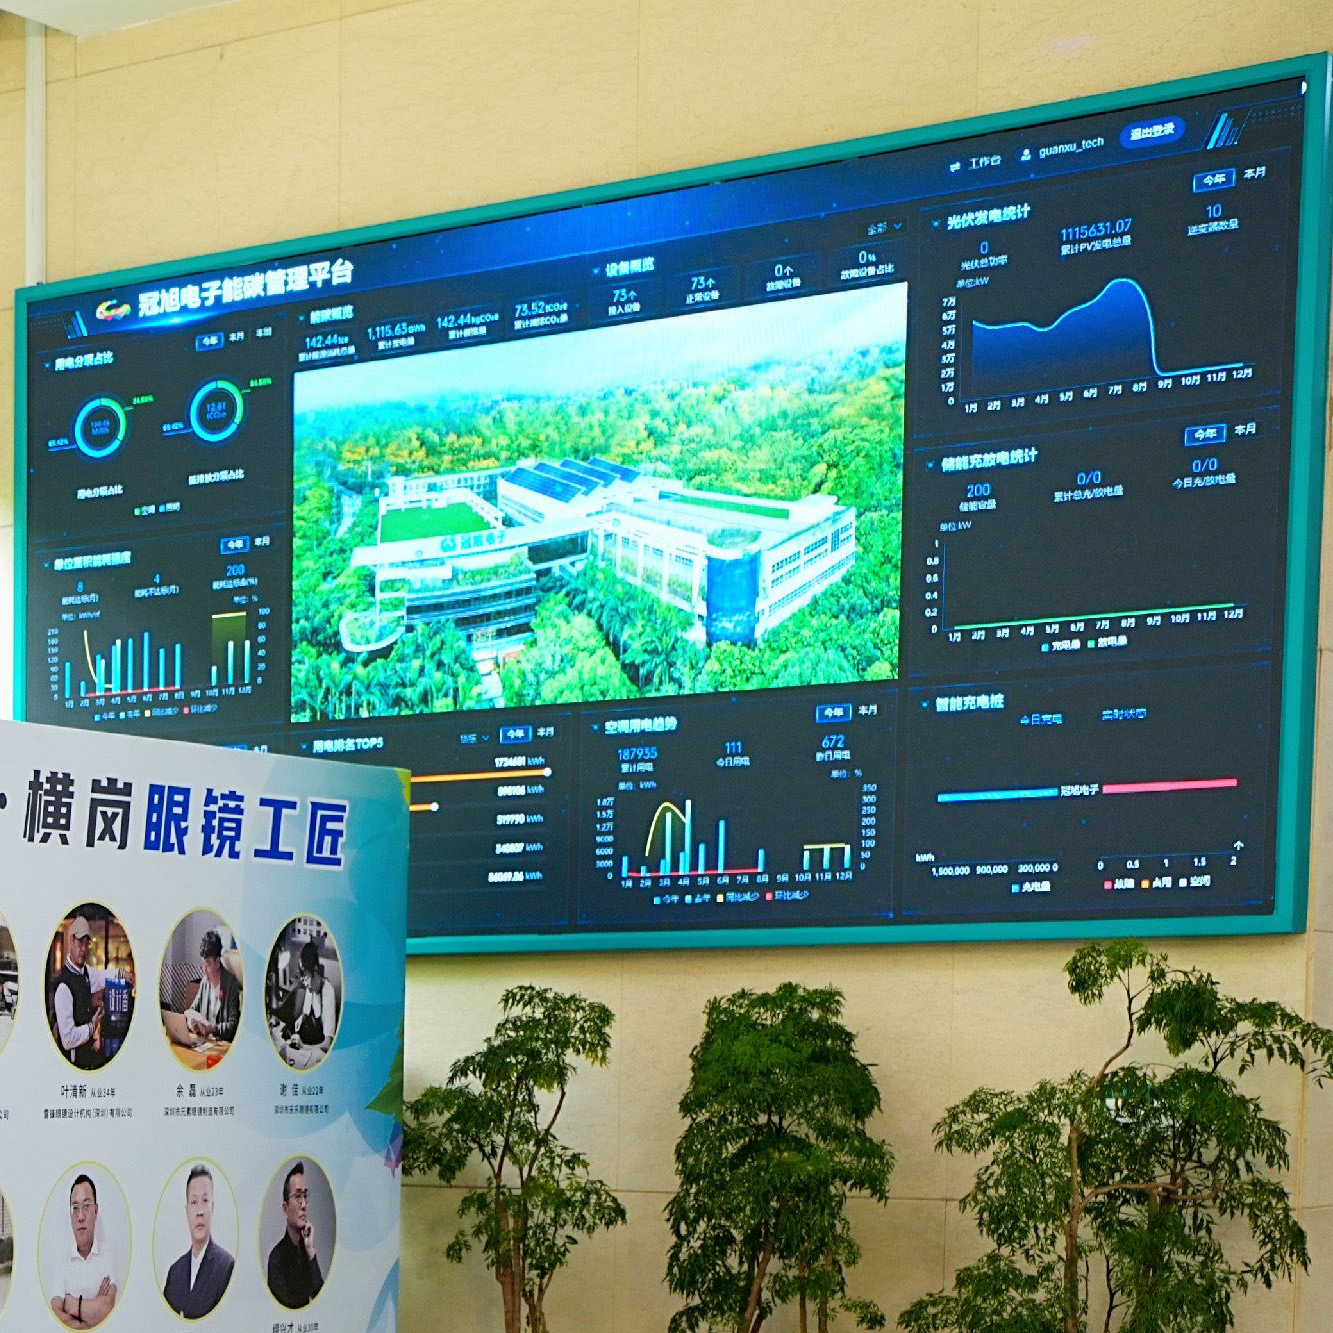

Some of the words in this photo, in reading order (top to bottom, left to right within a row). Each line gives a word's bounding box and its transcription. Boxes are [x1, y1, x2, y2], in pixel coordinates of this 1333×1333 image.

[968, 155, 1002, 170] 工作台
[1203, 173, 1226, 187] 今年
[1243, 166, 1266, 181] 本月
[947, 203, 1030, 230] 光伏发电统计
[1206, 204, 1222, 218] 10
[1060, 218, 1132, 241] 1115631.07
[139, 258, 354, 317] 冠旭电子能碳管理平台
[1195, 427, 1217, 441] 今年
[1234, 422, 1256, 436] 本月
[967, 483, 991, 498] 200
[822, 735, 845, 749] 672
